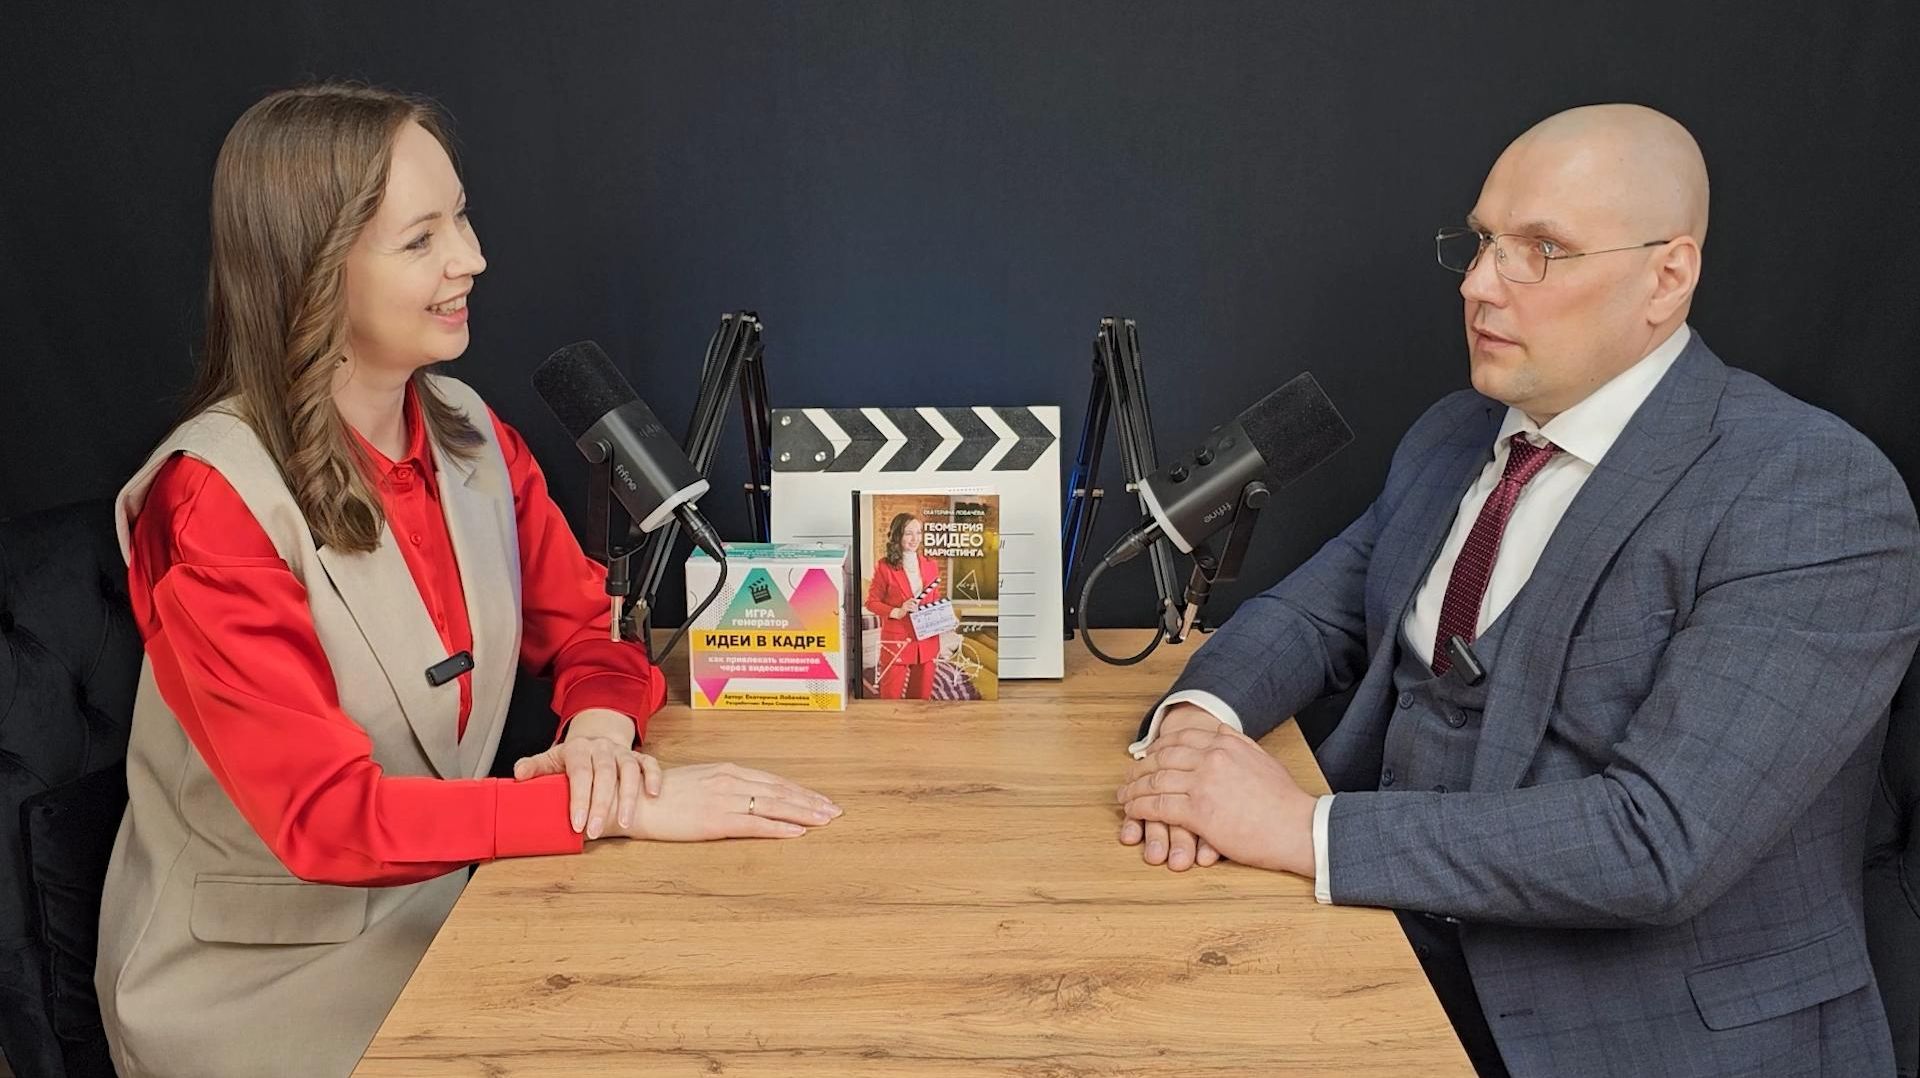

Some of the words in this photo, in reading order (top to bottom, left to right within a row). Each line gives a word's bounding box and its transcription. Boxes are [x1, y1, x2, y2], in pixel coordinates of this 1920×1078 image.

[614, 463, 637, 491] fifine
[924, 522, 984, 532] ГЕОМЕТРИЯ
[924, 532, 984, 548] ВИДЕО
[924, 547, 984, 557] МАРКЕТИНГА
[745, 608, 775, 618] ИГРА
[732, 619, 789, 629] генератор
[706, 634, 751, 648] ИДЕИ
[757, 635, 767, 647] В
[773, 635, 826, 649] КАДРЕ
[726, 656, 777, 664] привлекать
[779, 657, 821, 665] клиентов
